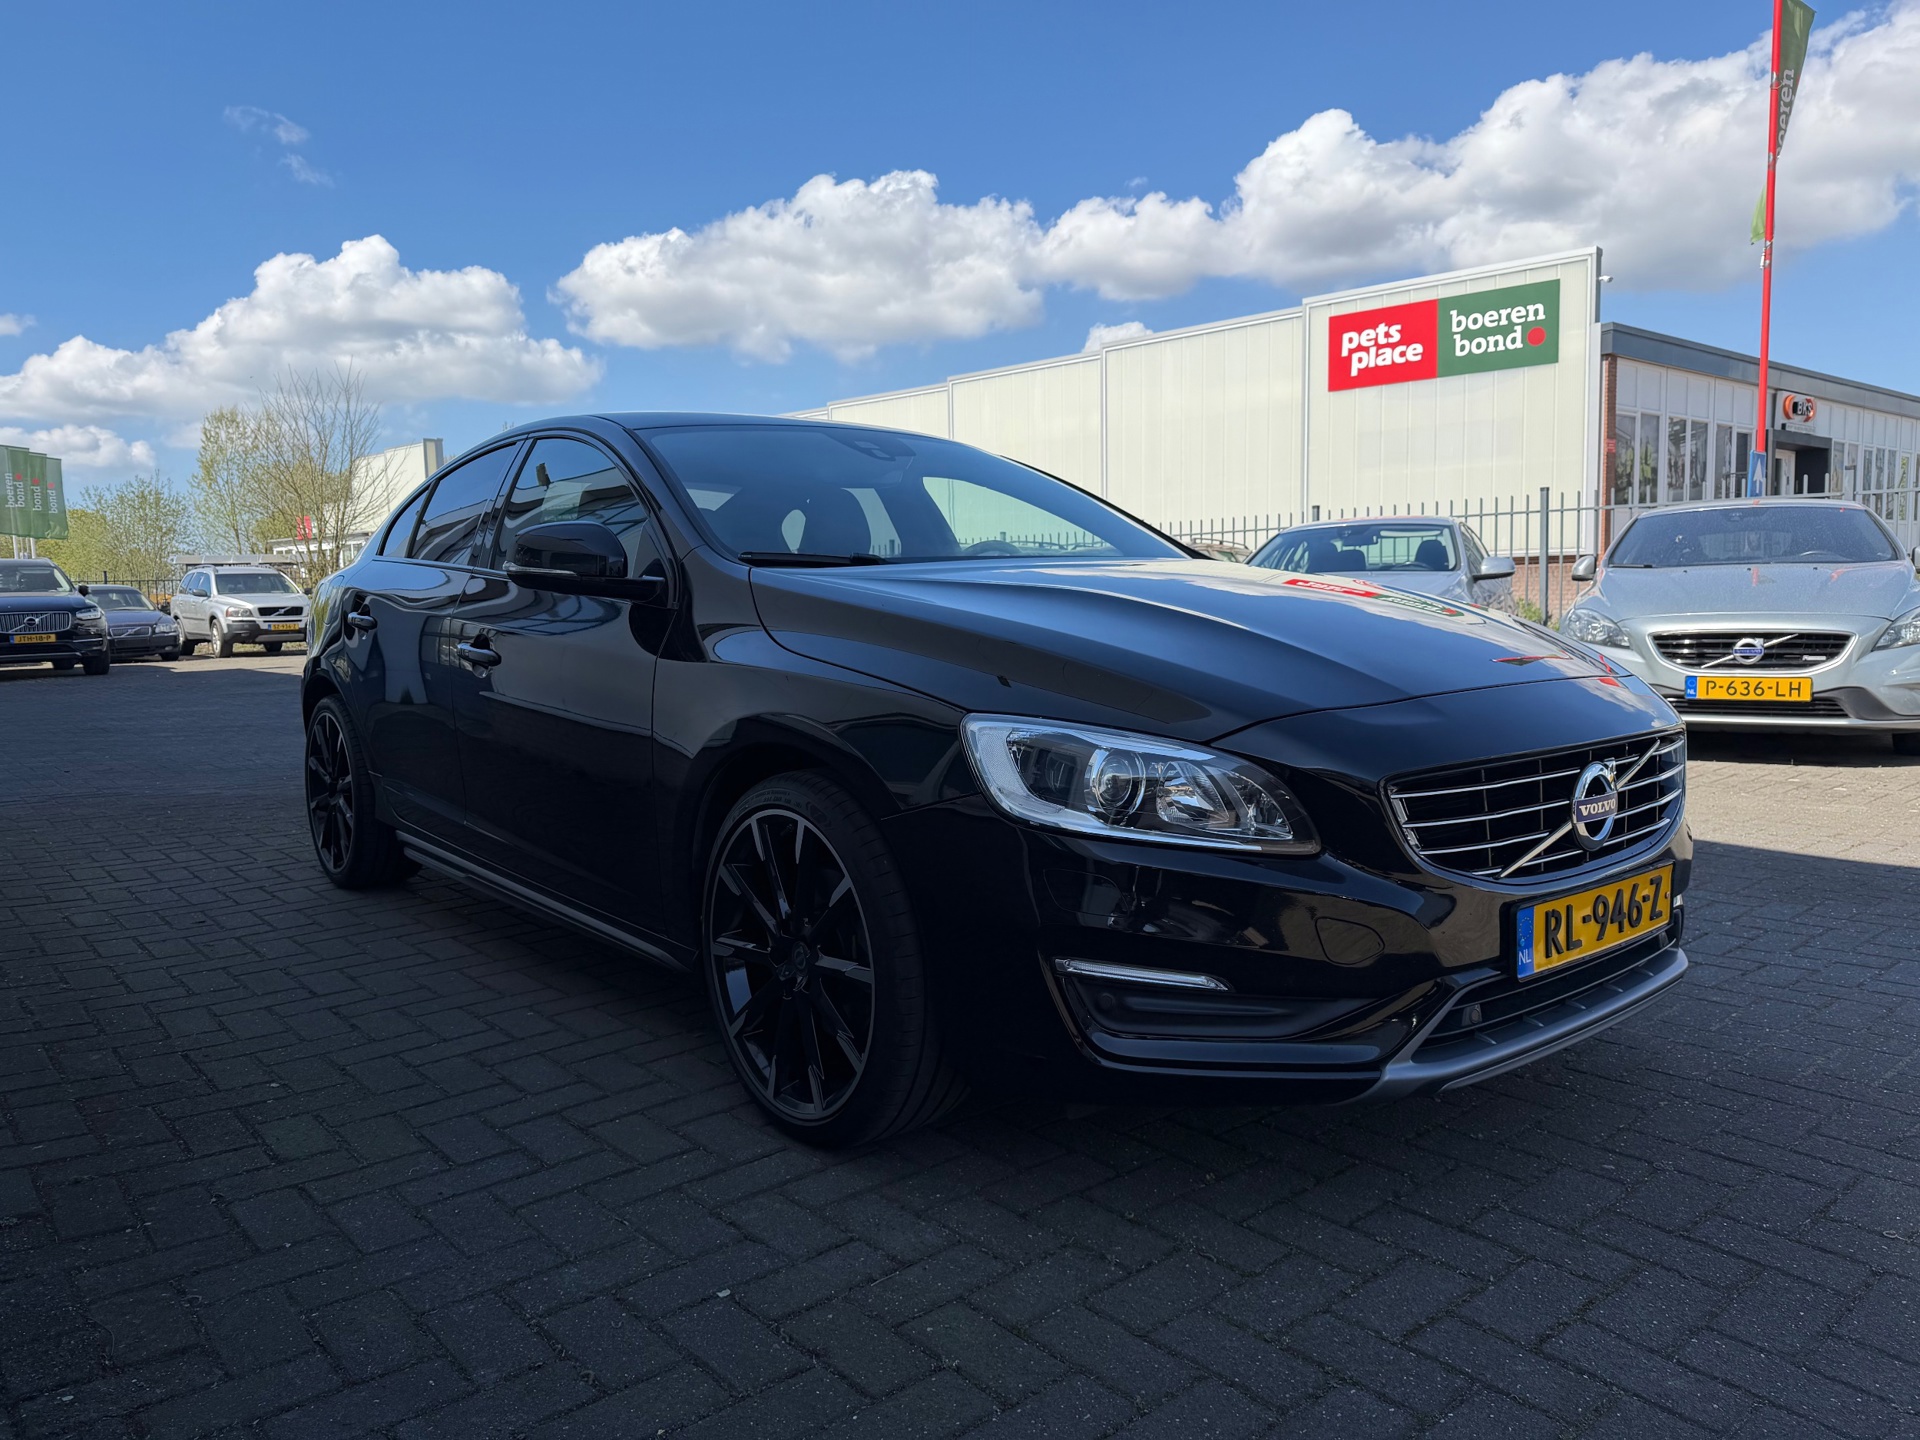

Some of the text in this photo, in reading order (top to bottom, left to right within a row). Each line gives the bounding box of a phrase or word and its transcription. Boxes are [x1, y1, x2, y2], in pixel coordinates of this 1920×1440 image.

[1450, 302, 1546, 333] boeren
[1341, 321, 1402, 357] pets
[1453, 325, 1523, 357] bond
[1350, 342, 1424, 377] place
[5, 473, 15, 507] boeren
[14, 482, 25, 507] bond
[31, 486, 41, 511] bond
[47, 490, 58, 513] bond
[1706, 680, 1801, 697] P-636-LH
[1578, 798, 1616, 817] VOLVO
[1544, 875, 1663, 959] RL-946-Z
[1518, 949, 1533, 966] NL
